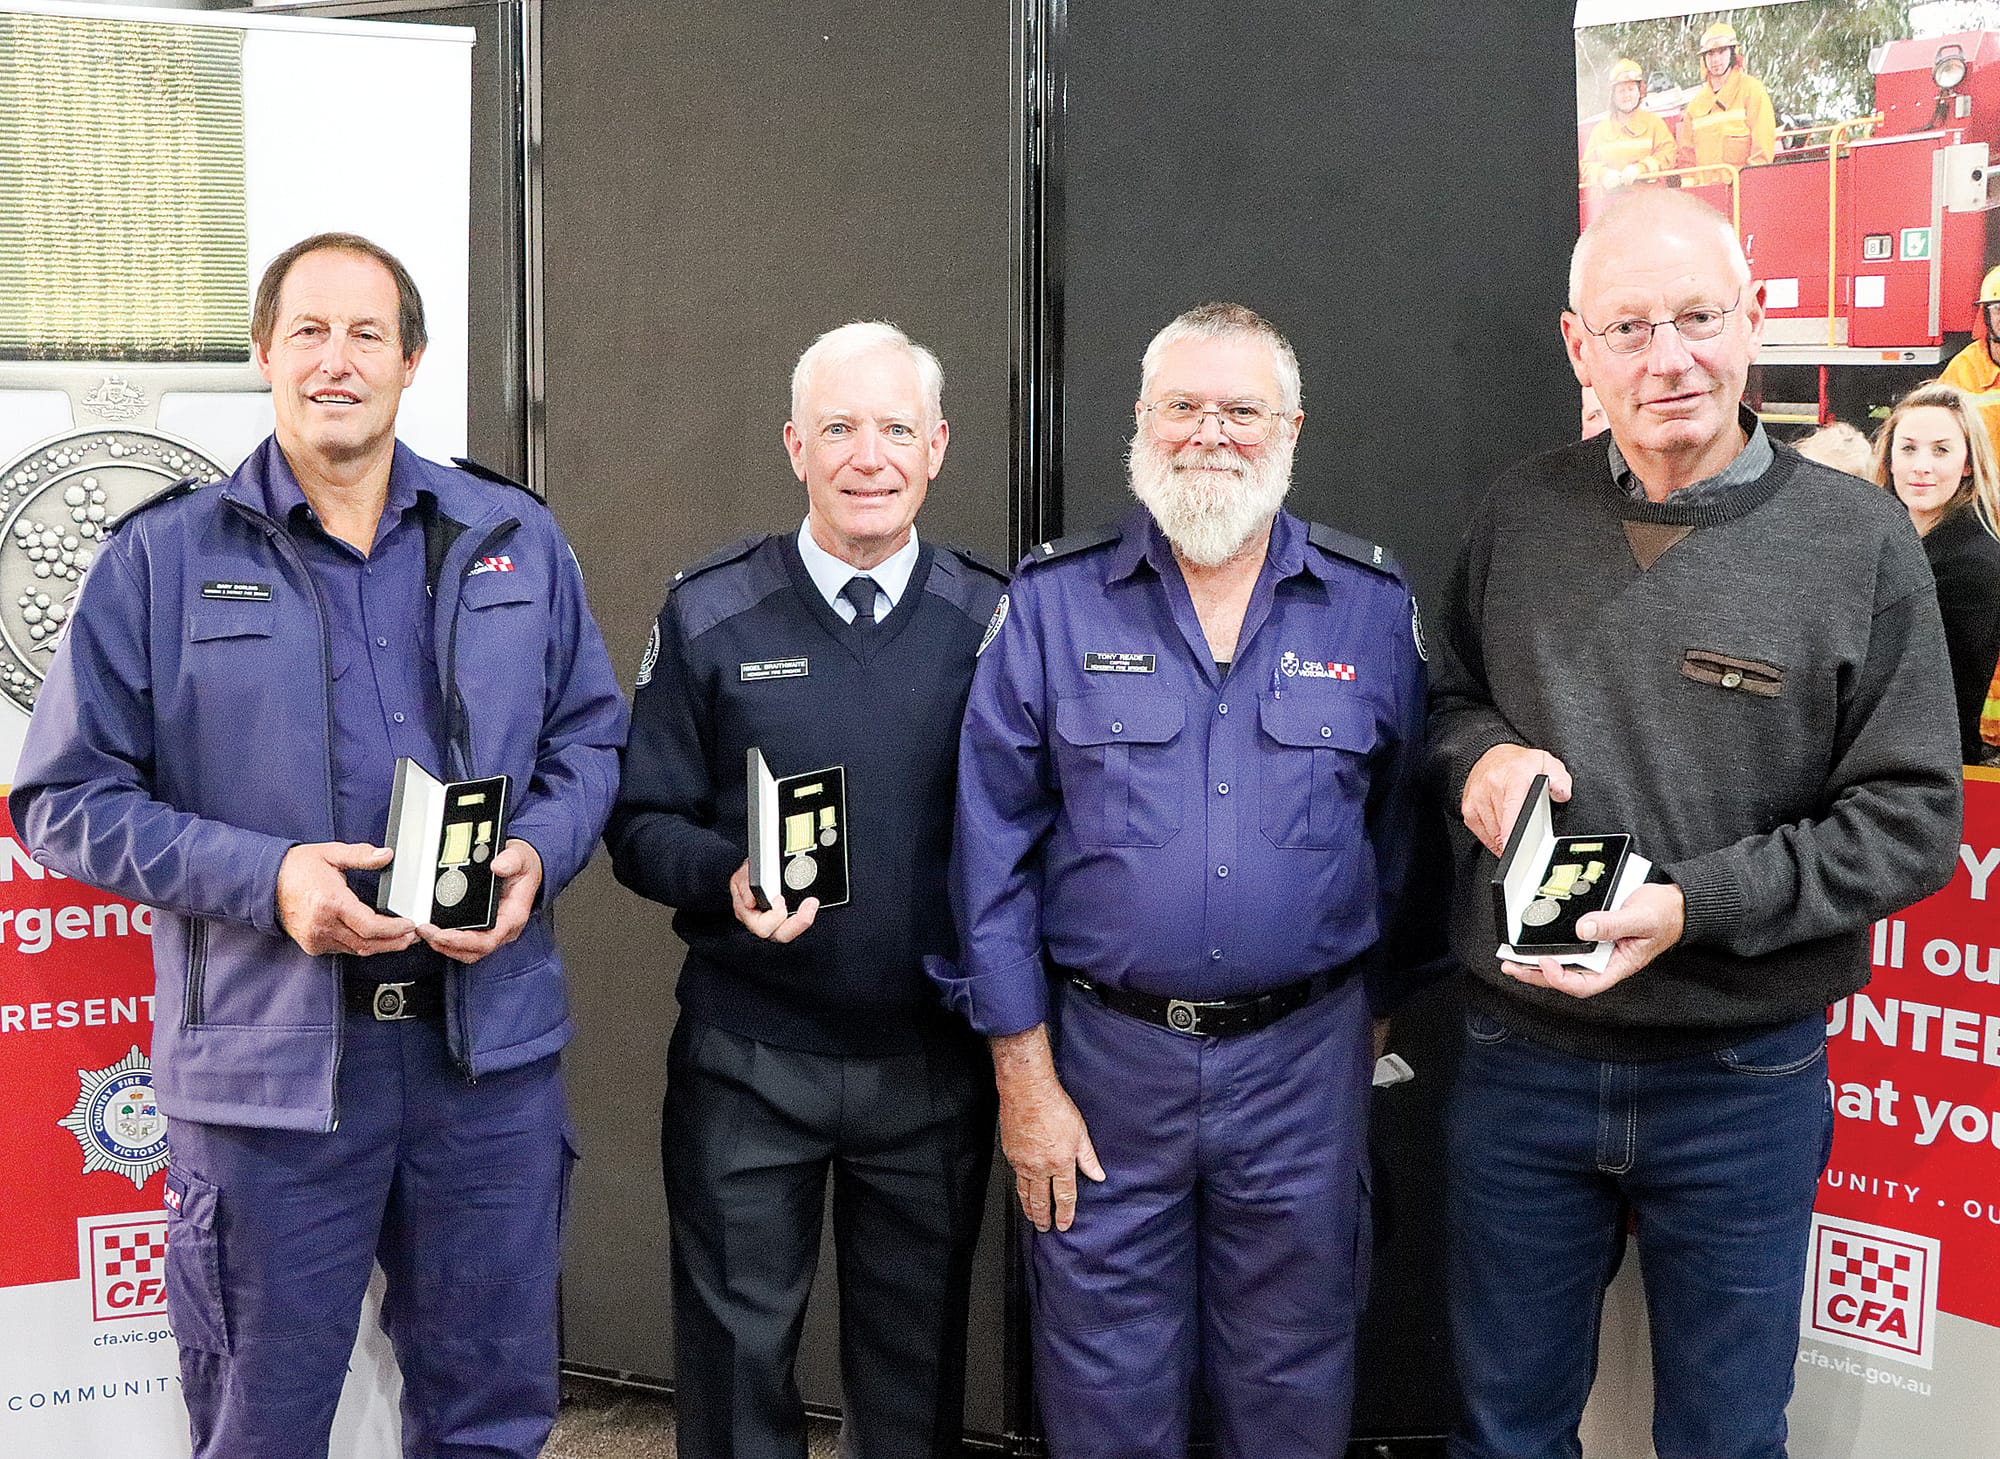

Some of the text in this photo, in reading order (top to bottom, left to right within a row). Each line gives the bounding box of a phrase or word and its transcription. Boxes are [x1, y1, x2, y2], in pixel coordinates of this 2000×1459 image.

[1297, 669, 1329, 678] VICTORIA
[1302, 661, 1325, 671] CFA
[94, 1077, 141, 1132] COUNTRY FIRE
[1913, 1094, 2000, 1150] yo
[113, 1141, 167, 1157] VICTORIA
[1827, 1293, 1907, 1339] CFA
[1799, 1349, 1932, 1397] cfa.vic.gov.au
